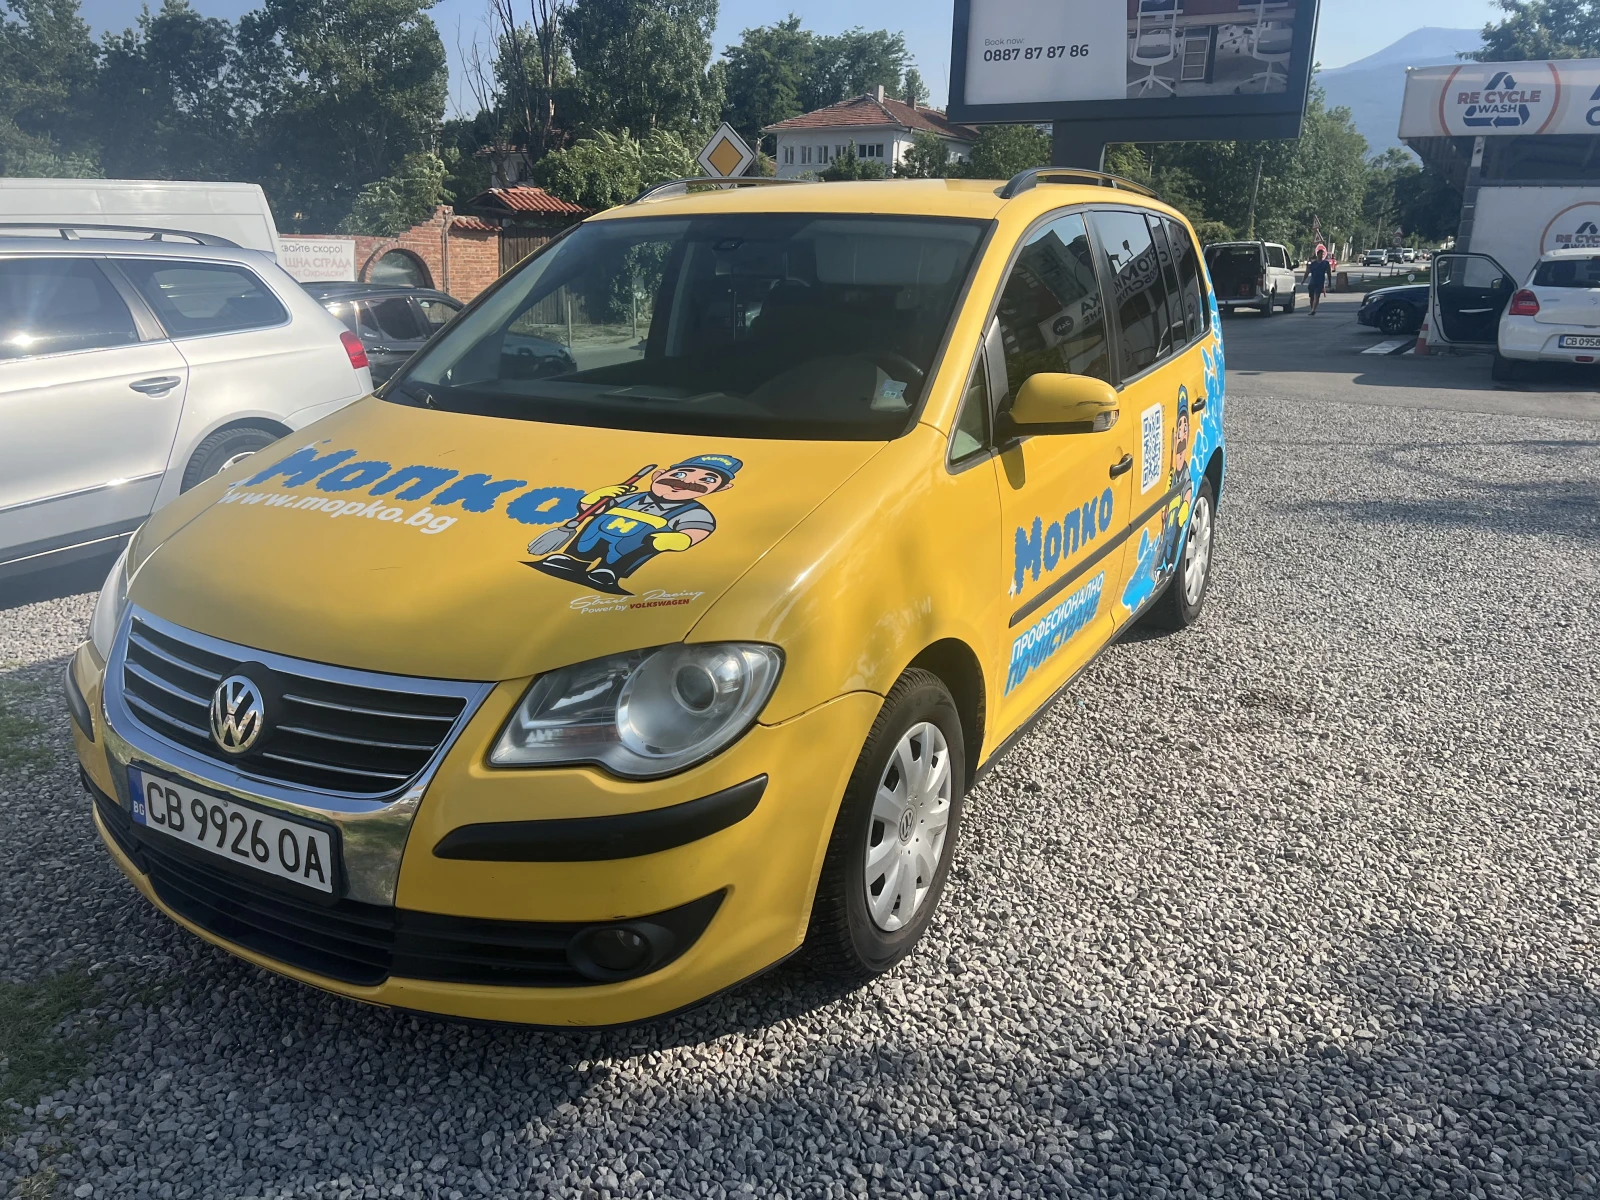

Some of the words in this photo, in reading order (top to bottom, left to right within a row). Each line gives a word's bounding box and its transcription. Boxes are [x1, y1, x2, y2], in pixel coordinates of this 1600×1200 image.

[984, 38, 1004, 46] Book
[1006, 37, 1025, 45] now:
[984, 48, 1020, 62] 0887
[1024, 47, 1043, 60] 87
[1047, 46, 1067, 59] 87
[1070, 44, 1089, 57] 86
[1457, 92, 1481, 104] RE
[1484, 90, 1541, 104] CYCLE
[1478, 104, 1517, 113] WASH
[218, 491, 458, 534] www.mopko.bg
[642, 588, 705, 601] Racing
[580, 605, 612, 614] Power
[615, 604, 628, 612] by
[629, 599, 690, 610] VOLKSWAGEN
[1011, 572, 1105, 664] ПРОФЕСИОНАЛНО
[1004, 596, 1100, 697] ПОЧИСТВАНЕ
[133, 801, 145, 816] BG
[146, 781, 185, 832] CB
[190, 798, 270, 863] 9926
